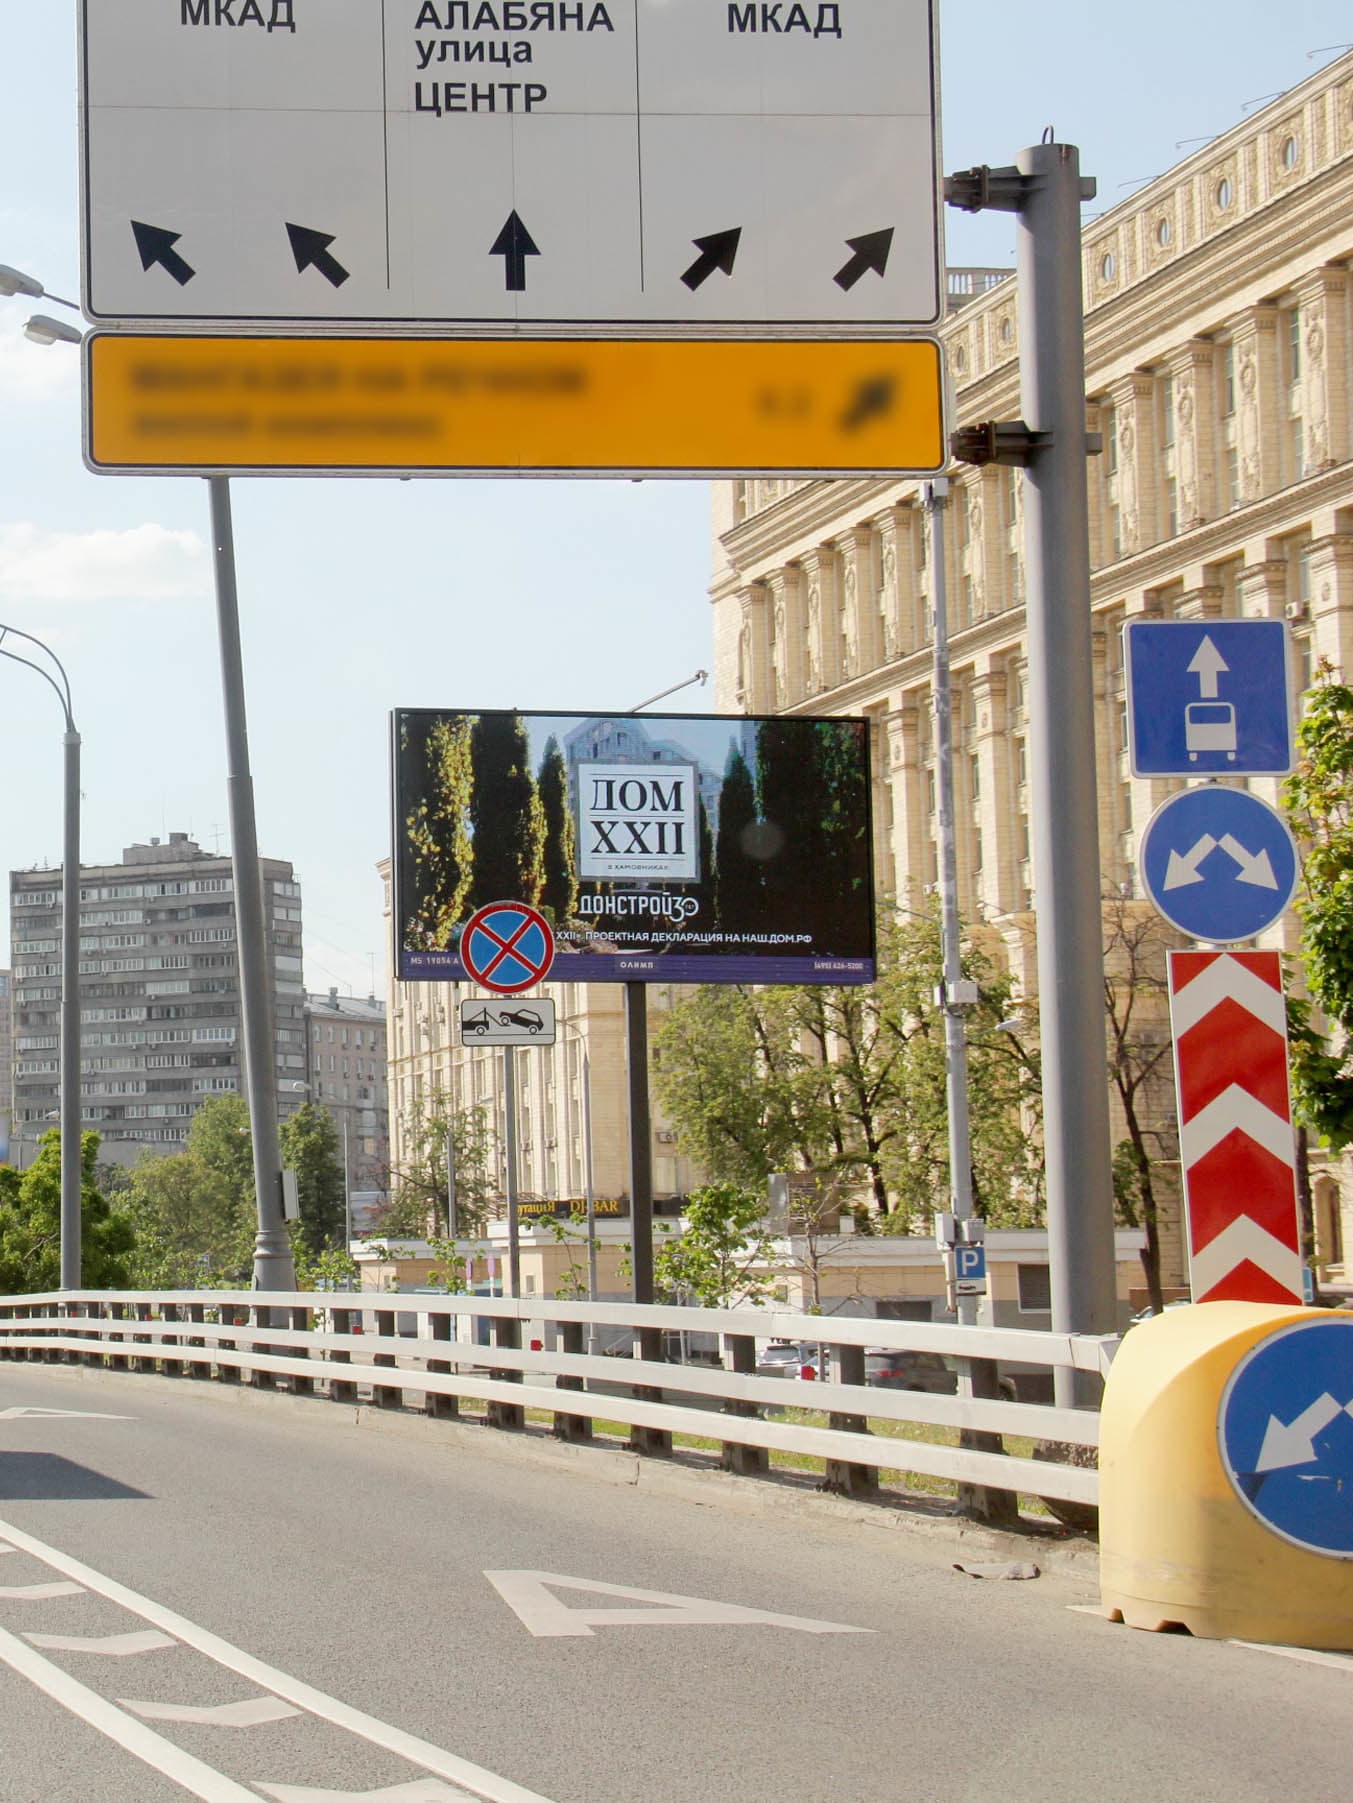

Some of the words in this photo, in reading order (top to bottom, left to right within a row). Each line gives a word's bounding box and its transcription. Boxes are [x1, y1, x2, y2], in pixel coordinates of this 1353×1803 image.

[180, 0, 296, 33] МКАД
[414, 0, 615, 32] АЛАБЯНА
[727, 3, 842, 39] МКАД
[415, 39, 533, 70] улица
[415, 82, 547, 117] ЦЕНТР
[590, 779, 685, 812] ДОМ
[590, 820, 686, 855] XXII
[578, 892, 672, 915] ДОНСТРОЙ
[585, 931, 649, 942] ПРОЕКТНАЯ
[650, 932, 723, 944] ДЕКЛАРАЦИЯ
[724, 934, 741, 943] НА
[619, 961, 654, 969] ОЛИМП
[961, 1250, 979, 1275] P
